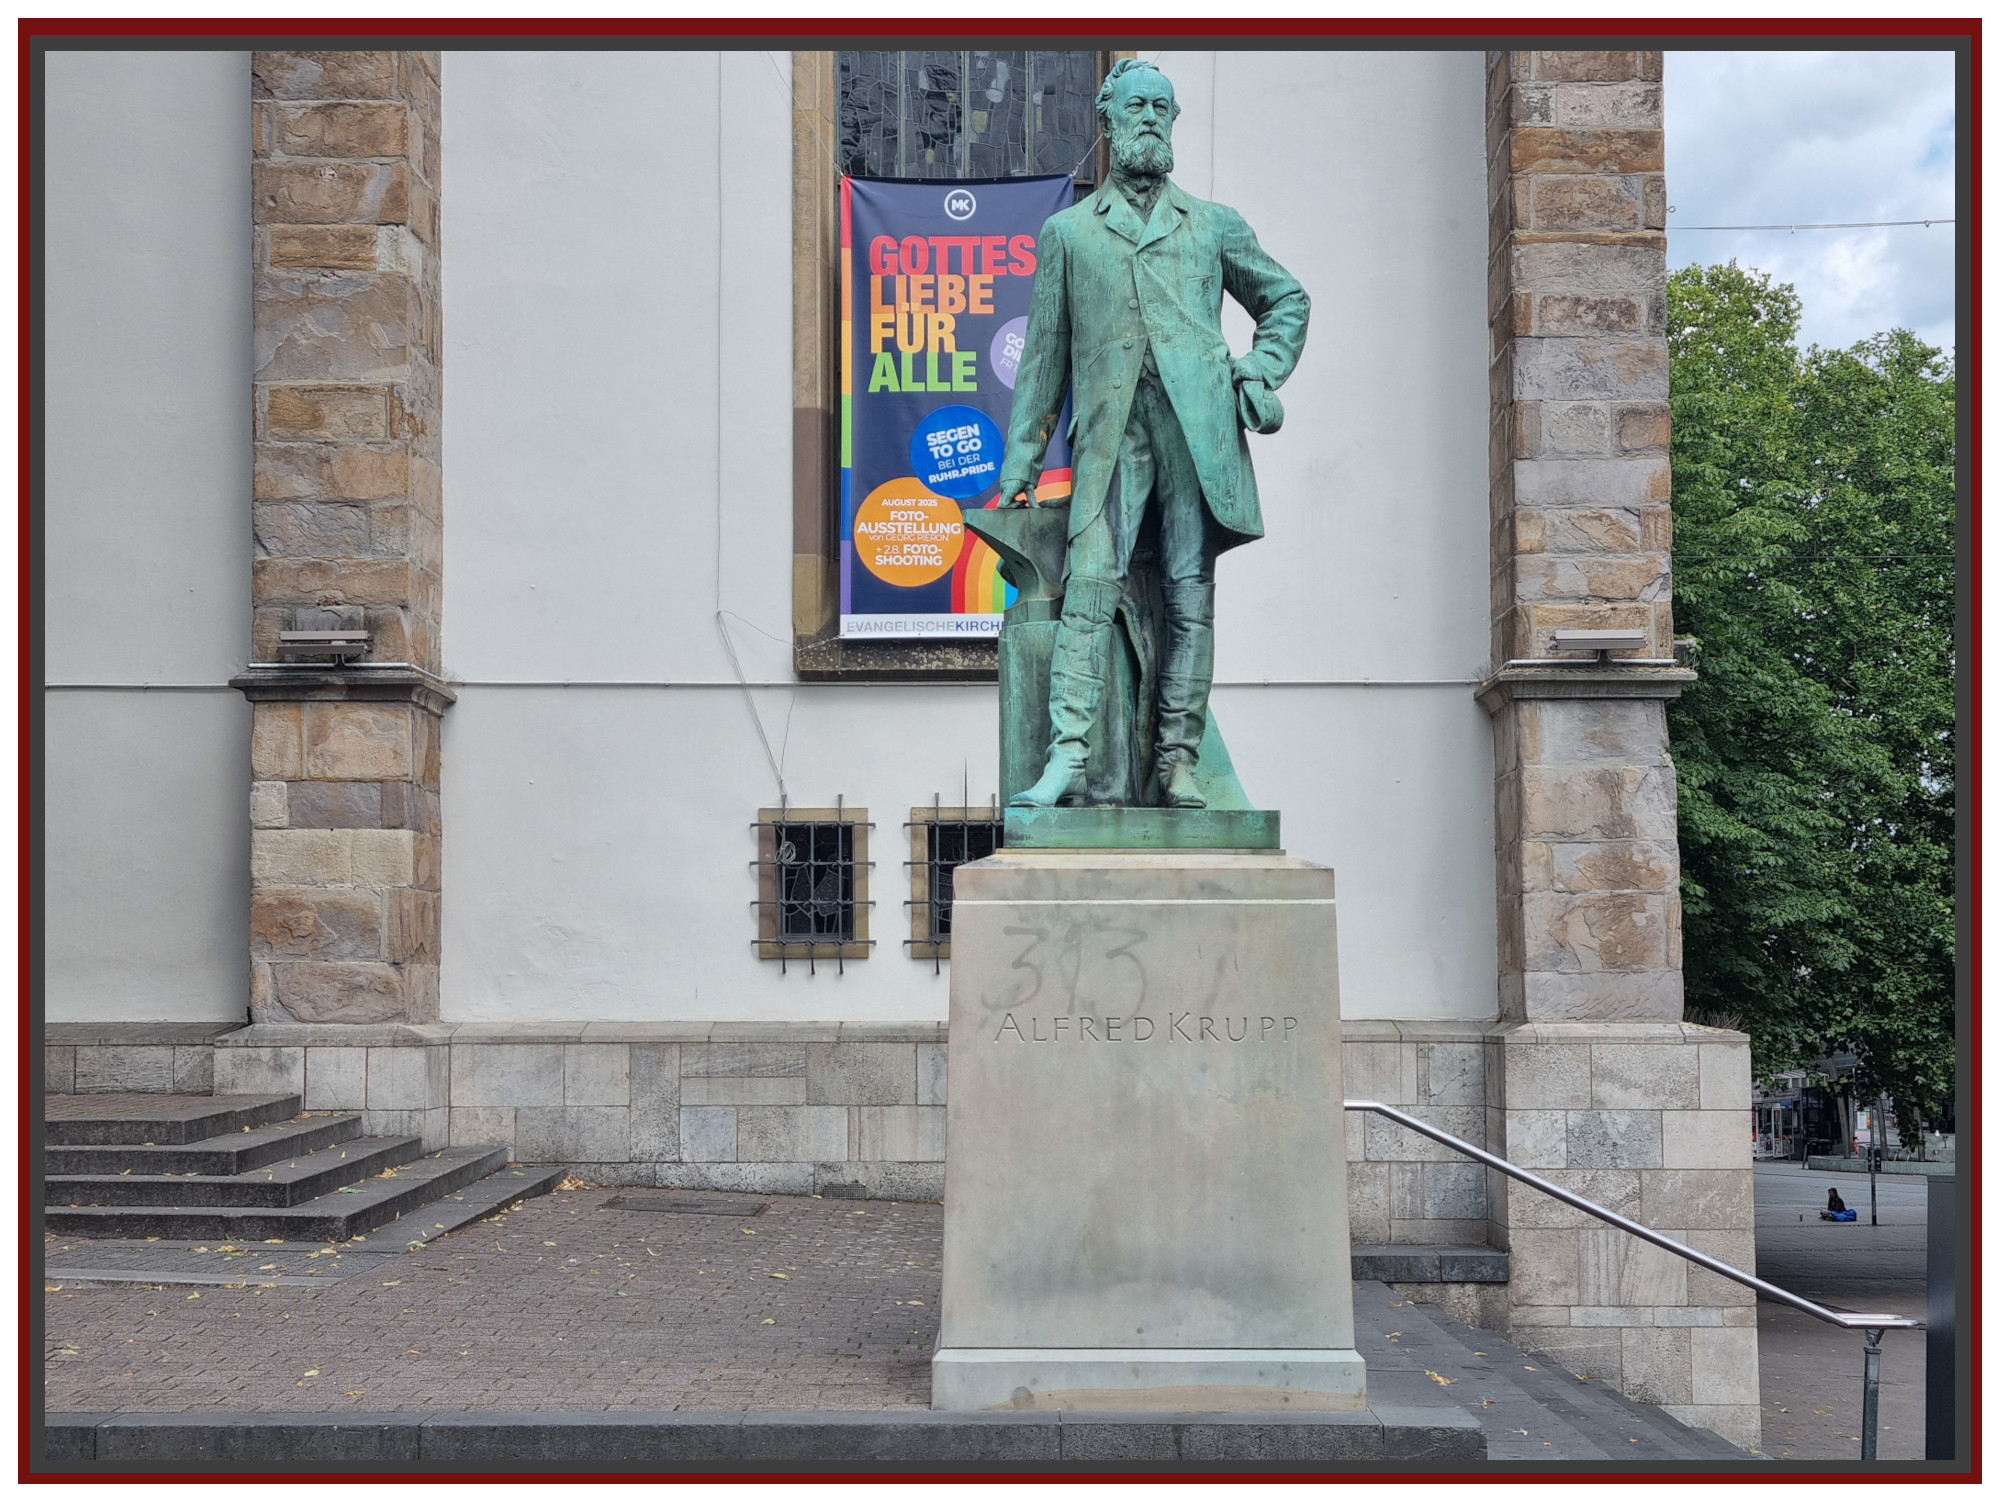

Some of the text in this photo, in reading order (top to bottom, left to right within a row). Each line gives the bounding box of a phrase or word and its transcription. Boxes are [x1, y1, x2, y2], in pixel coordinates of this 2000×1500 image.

[951, 199, 970, 211] MK
[869, 234, 1037, 276] GOTTES
[870, 274, 995, 315] LIEBE
[870, 302, 957, 354] FÜR
[868, 351, 978, 393] ALLE
[926, 423, 980, 446] SEGEN
[929, 437, 982, 459] TO GO
[937, 453, 981, 470] BEI DER
[928, 461, 996, 484] RUHR.PRIDE
[881, 498, 938, 507] AUGUST 2025
[890, 510, 929, 521] FOTO-
[857, 521, 961, 534] AUSSTELLUNG
[917, 534, 949, 542] PIERON
[883, 545, 901, 555] 2.8.
[903, 544, 942, 555] FOTO-
[875, 555, 943, 566] SHOOTING
[993, 1011, 1299, 1043] ALFRED KRUPP
